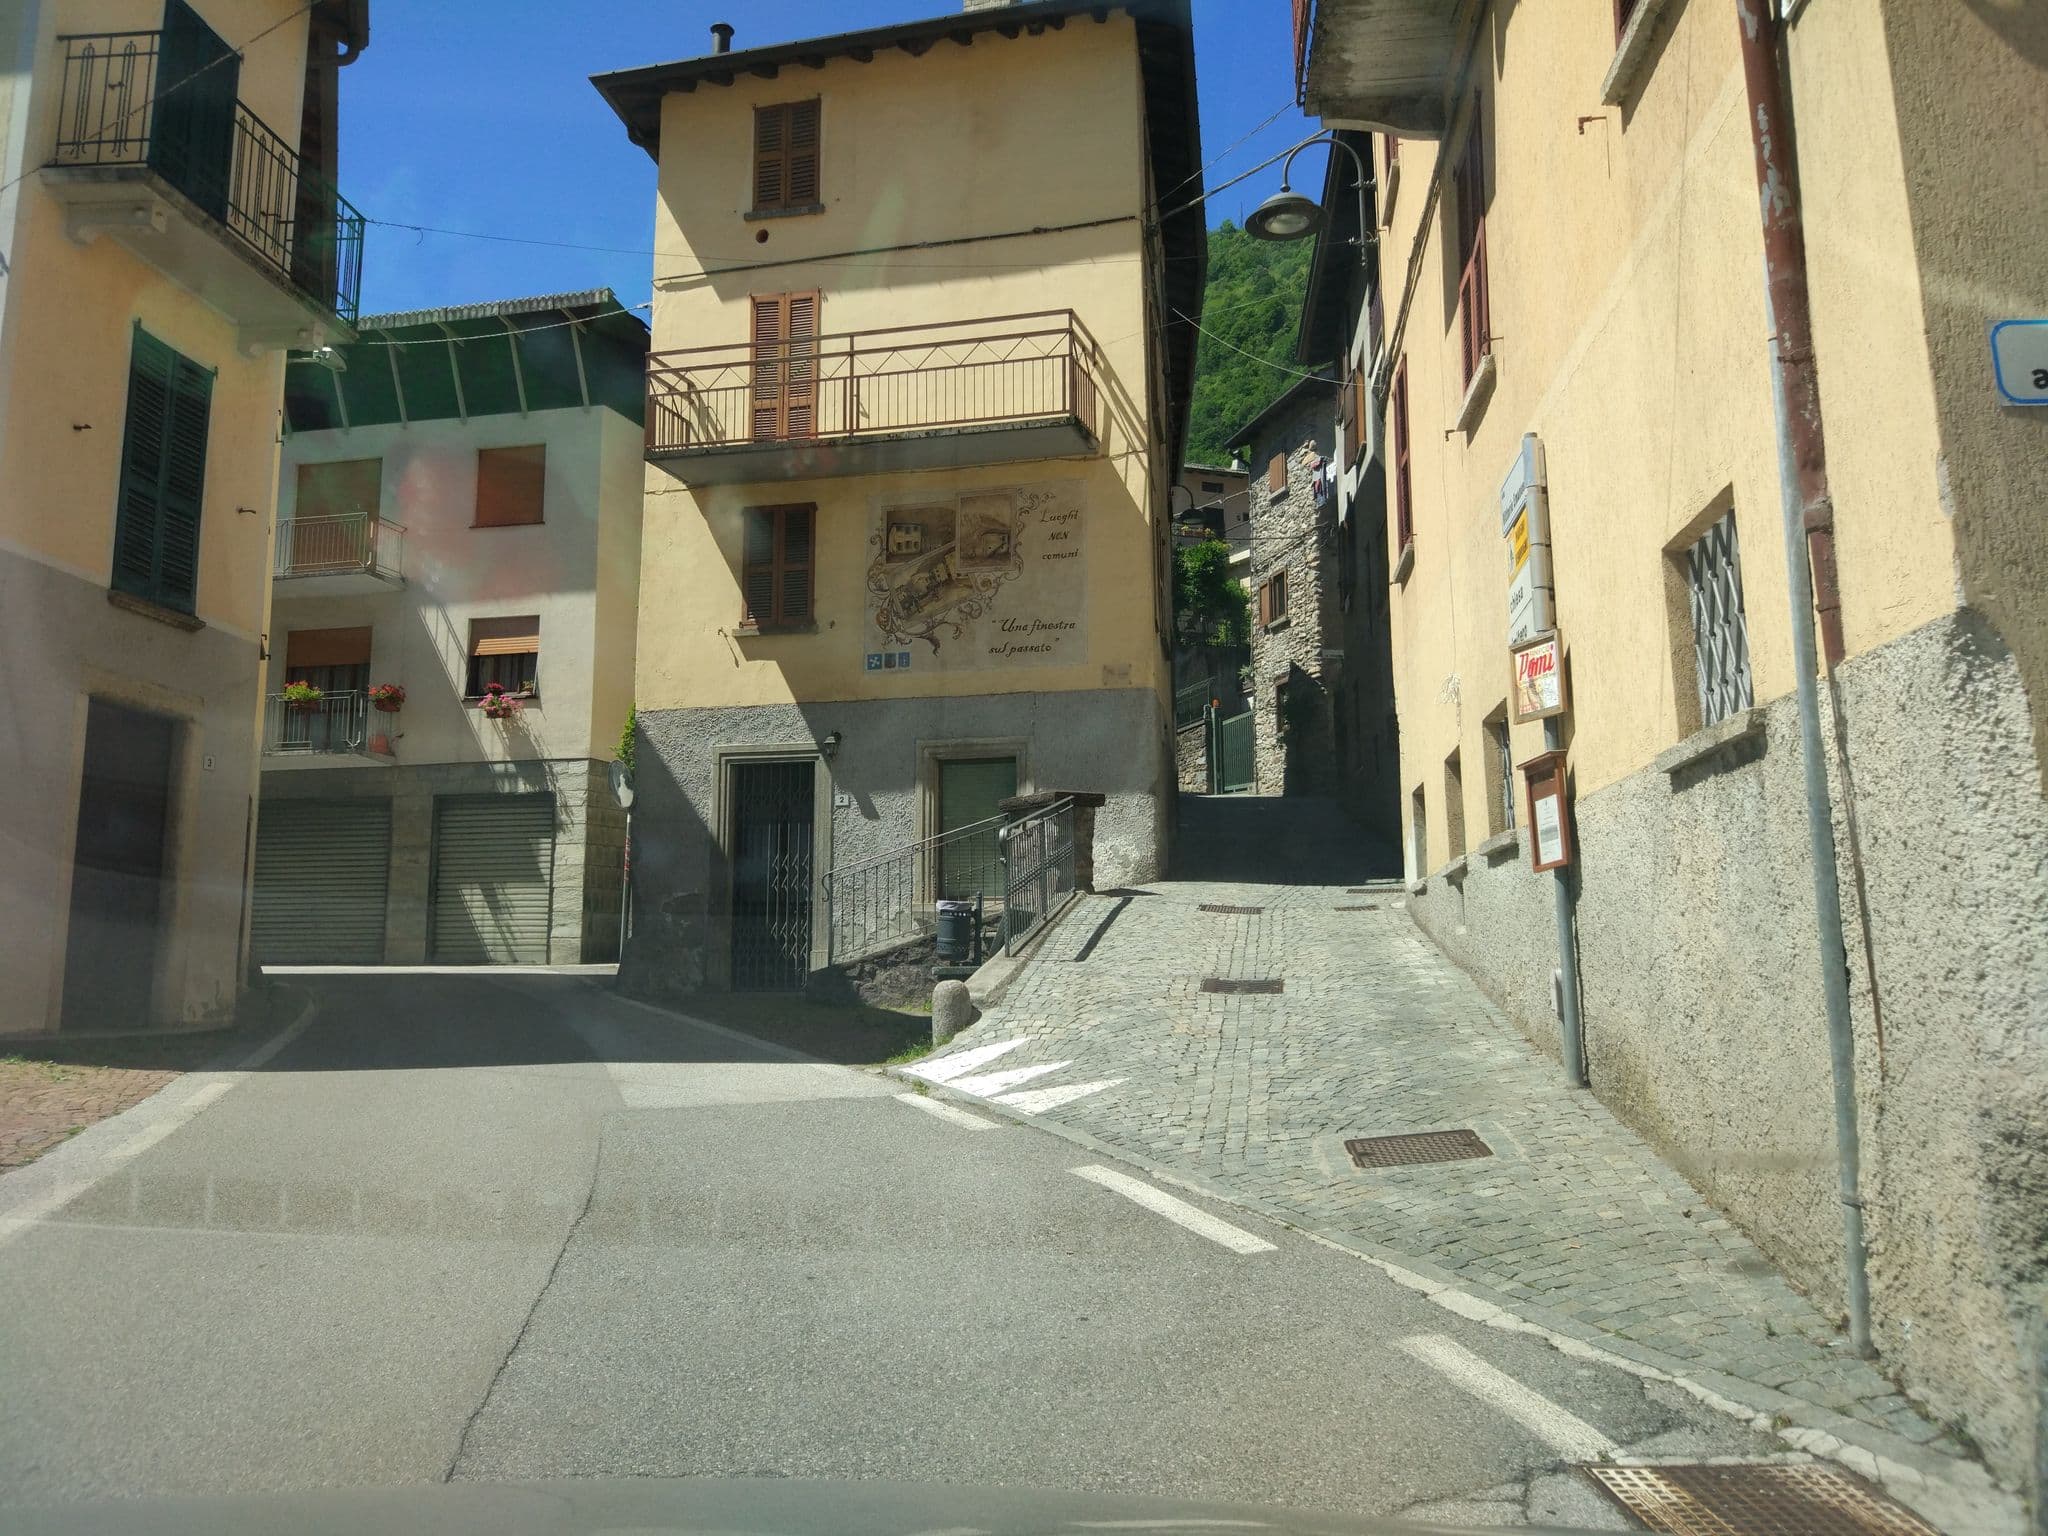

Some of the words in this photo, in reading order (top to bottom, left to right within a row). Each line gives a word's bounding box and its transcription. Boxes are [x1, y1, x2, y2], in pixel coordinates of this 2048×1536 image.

[1040, 509, 1079, 525] Luoghi
[1042, 548, 1079, 560] comuni
[1027, 618, 1076, 636] finestra
[988, 642, 1009, 654] sul
